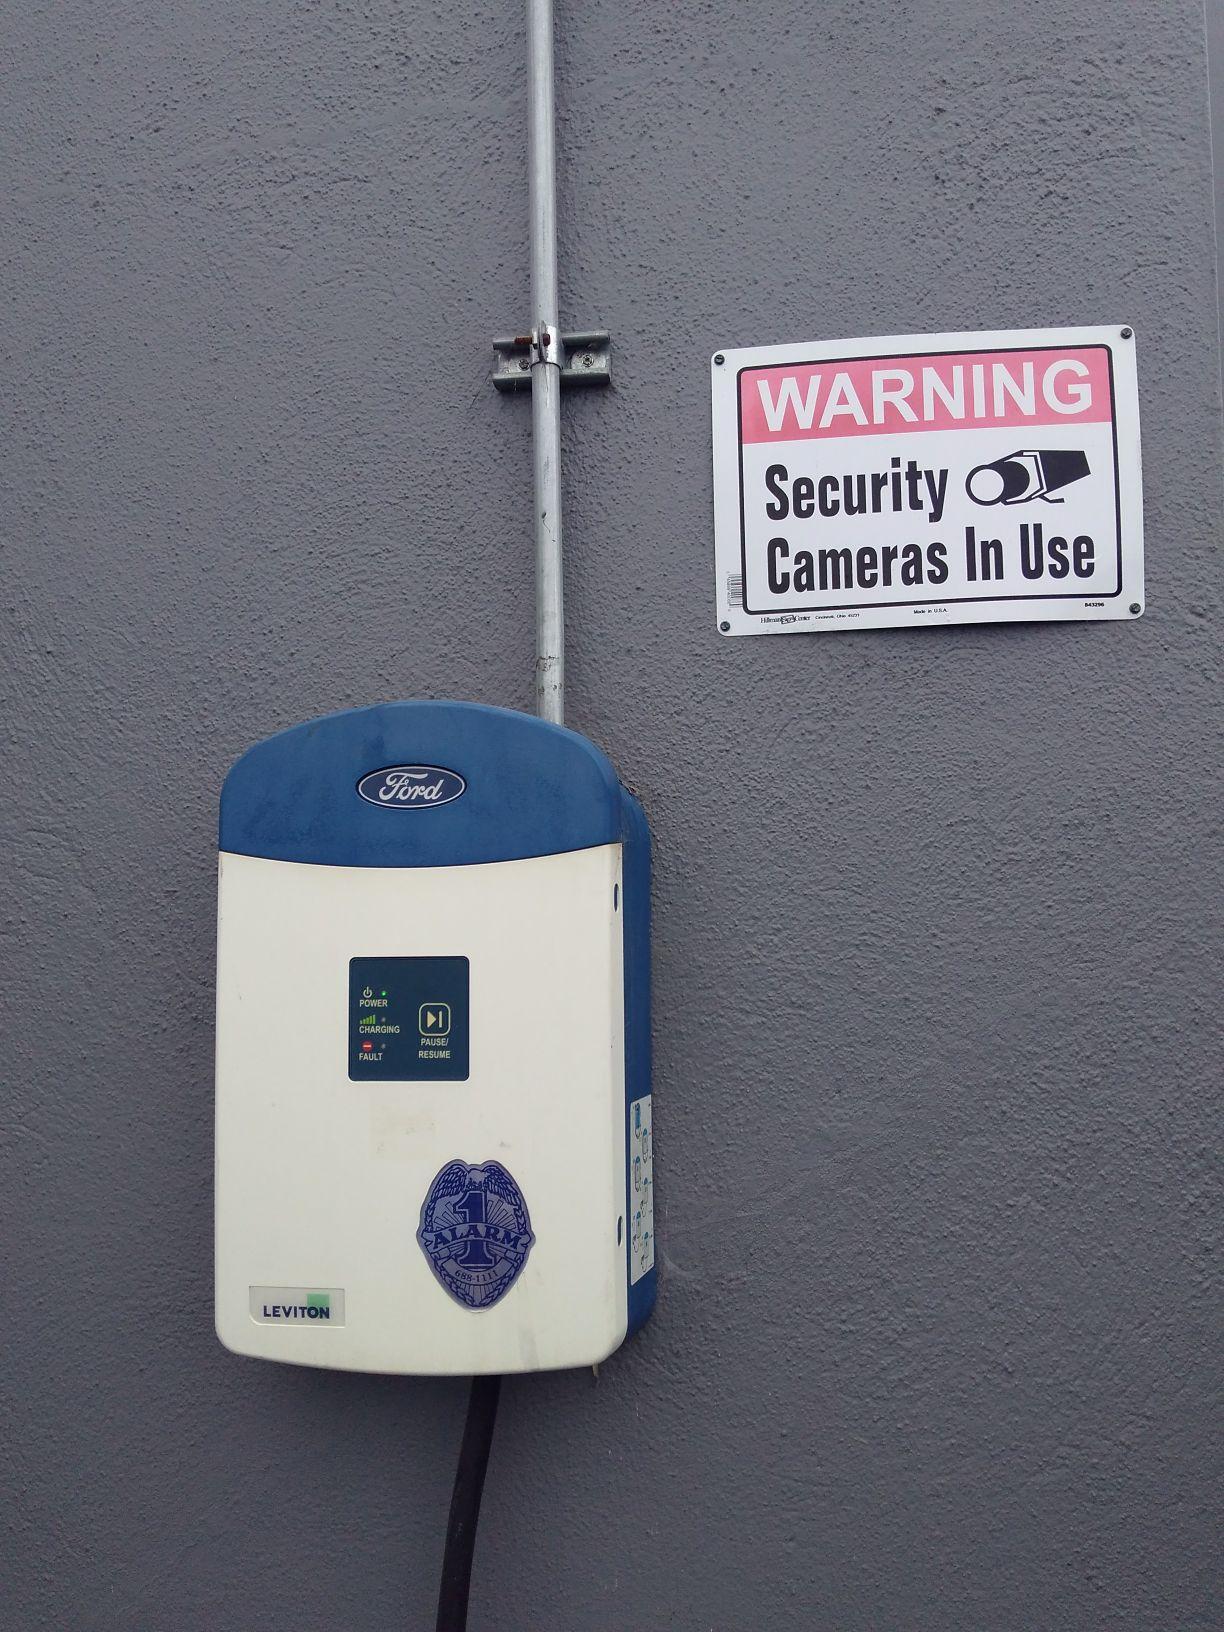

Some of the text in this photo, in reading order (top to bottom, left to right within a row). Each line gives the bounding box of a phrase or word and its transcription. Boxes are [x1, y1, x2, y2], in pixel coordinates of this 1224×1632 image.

[756, 359, 1093, 432] WARNING
[765, 456, 949, 523] Security
[767, 537, 949, 594] Cameras
[966, 526, 1004, 582] In
[1019, 523, 1095, 580] Use
[378, 772, 444, 801] Ford
[359, 999, 388, 1008] POWER
[359, 1025, 401, 1034] CHARGING
[420, 1038, 449, 1047] PAUSE/
[358, 1052, 383, 1061] FAULT
[418, 1050, 451, 1059] RESUME
[432, 1224, 522, 1250] ALARM
[454, 1268, 499, 1283] 688-1111
[263, 1305, 330, 1319] LEVITON
